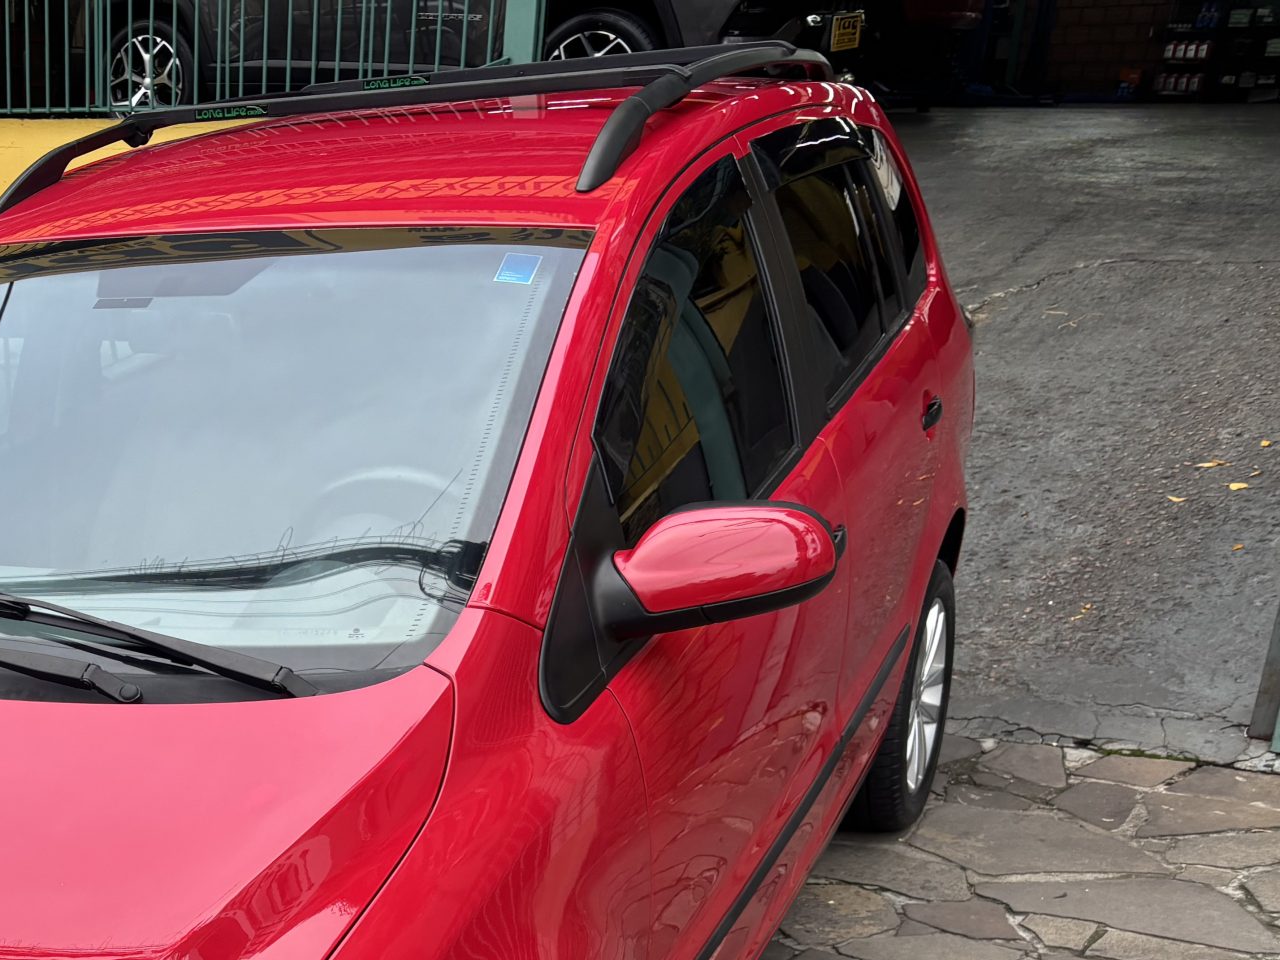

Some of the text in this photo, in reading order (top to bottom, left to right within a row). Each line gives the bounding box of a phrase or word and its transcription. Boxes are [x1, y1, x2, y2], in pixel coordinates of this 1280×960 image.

[364, 80, 389, 89] LONG
[391, 78, 411, 87] LIFE
[195, 108, 223, 119] LONG
[224, 107, 247, 117] LIFE
